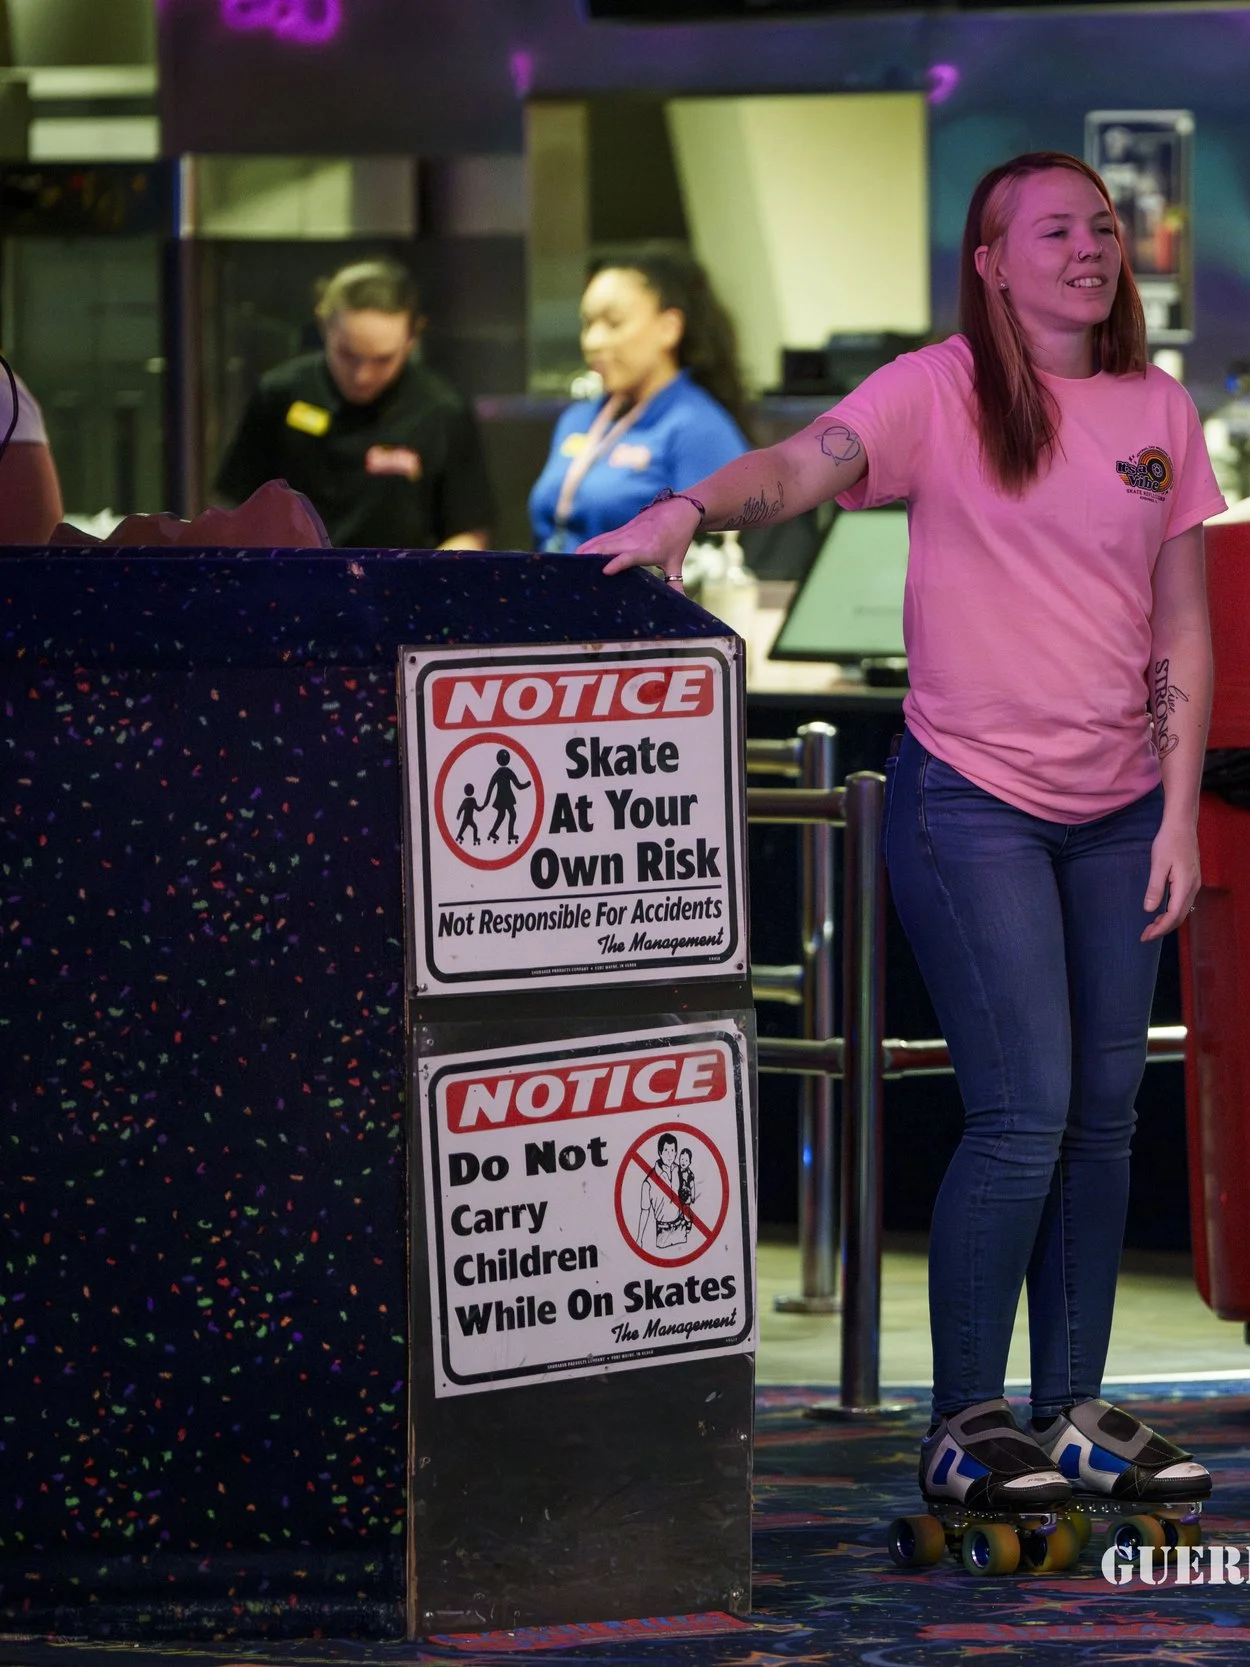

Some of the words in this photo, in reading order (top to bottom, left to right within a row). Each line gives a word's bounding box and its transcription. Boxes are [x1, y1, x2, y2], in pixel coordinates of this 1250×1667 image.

[1128, 474, 1160, 492] Vibe
[445, 669, 706, 724] NOTICE
[565, 736, 680, 779] Skate
[548, 792, 594, 835] At
[605, 789, 698, 831] Your
[530, 847, 624, 890] Own
[636, 837, 721, 882] Risk
[438, 911, 475, 937] Not
[479, 903, 592, 939] Responsible
[595, 901, 628, 927] For
[631, 896, 723, 924] Accidents
[597, 934, 625, 955] The
[628, 926, 724, 956] Management
[458, 1053, 718, 1128] NOTICE
[448, 1151, 509, 1187] Do
[525, 1136, 608, 1176] Not
[450, 1201, 548, 1236] Carry
[453, 1244, 598, 1287] Children
[455, 1292, 556, 1337] While
[567, 1288, 614, 1321] On
[624, 1274, 737, 1313] Skates
[611, 1323, 640, 1343] The
[642, 1307, 737, 1346] Management
